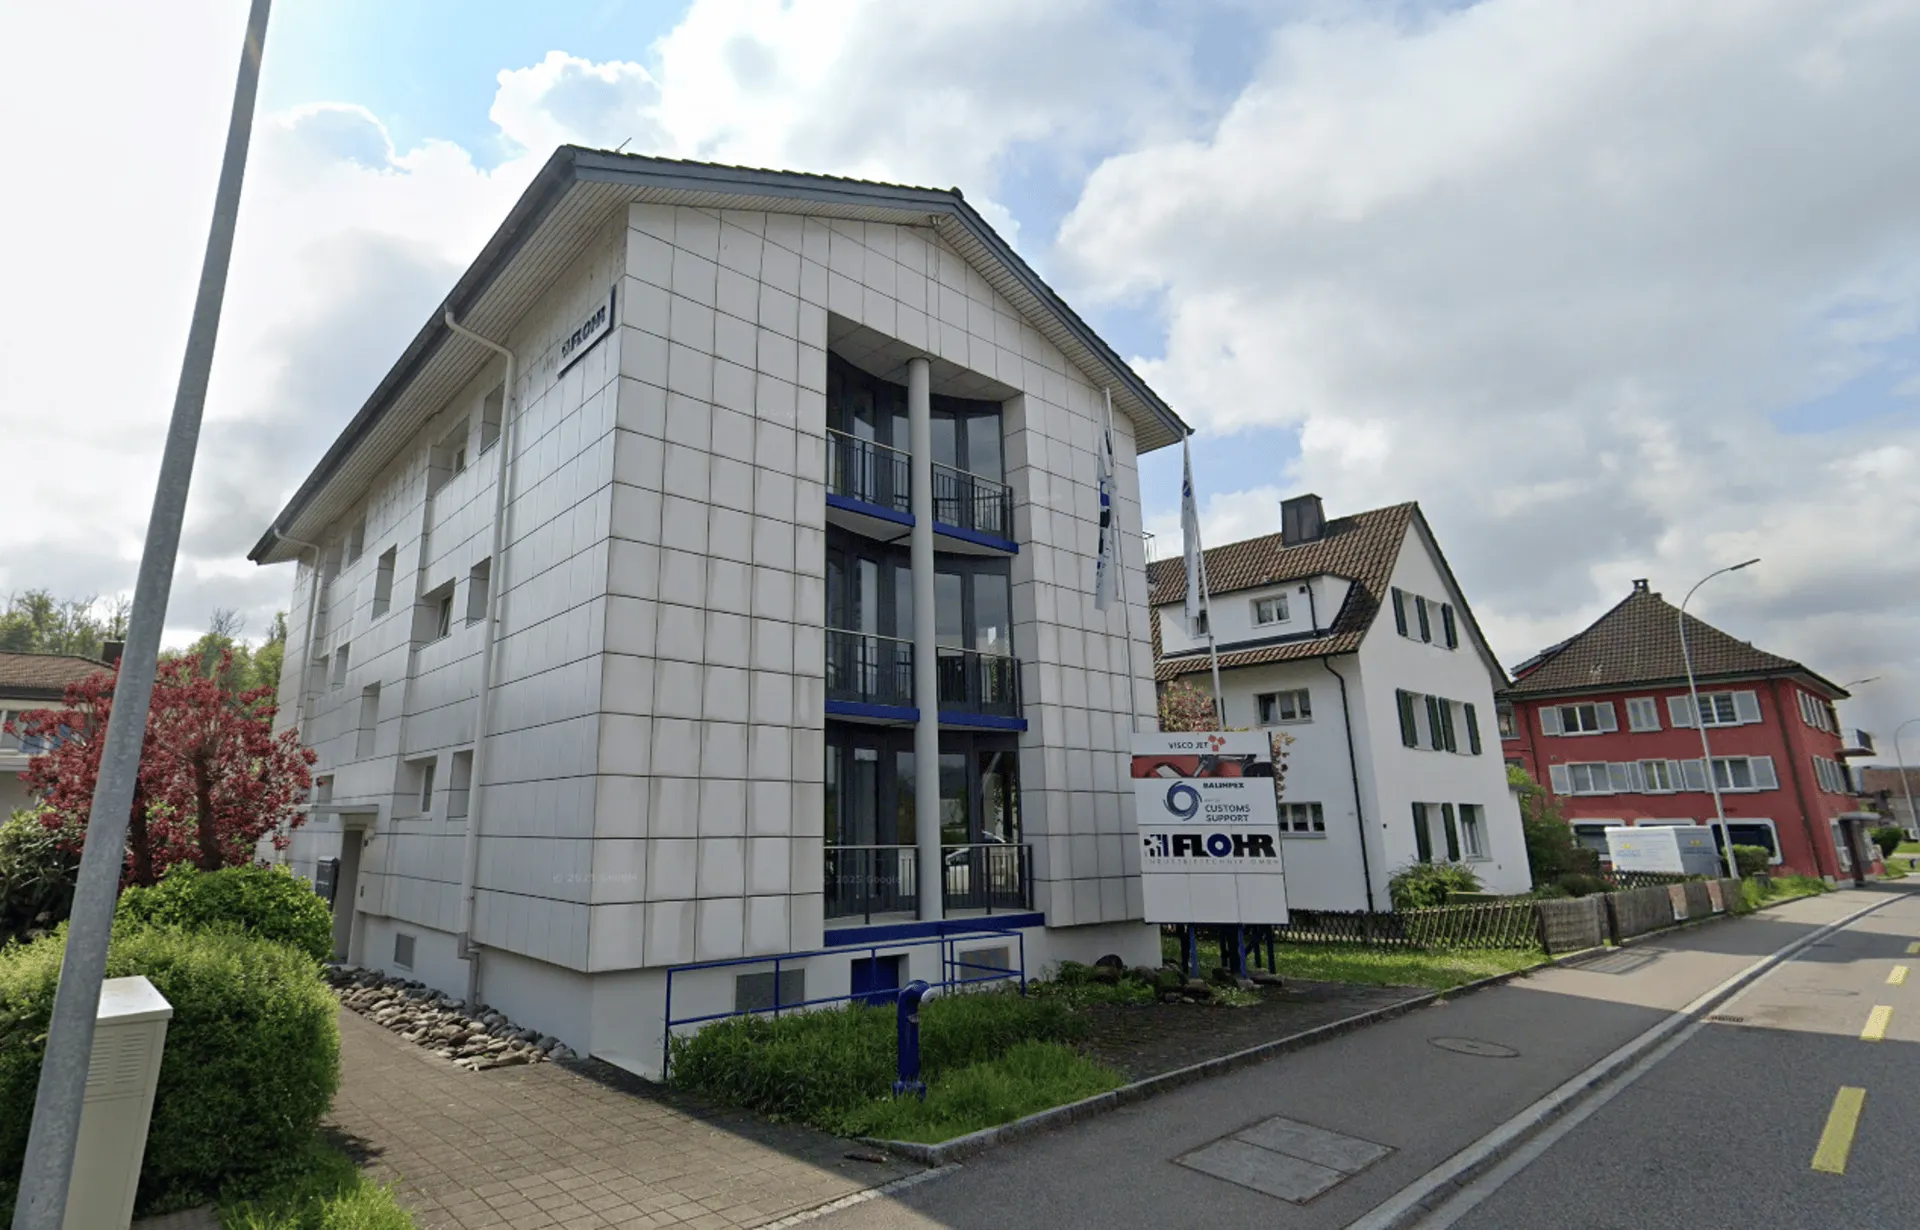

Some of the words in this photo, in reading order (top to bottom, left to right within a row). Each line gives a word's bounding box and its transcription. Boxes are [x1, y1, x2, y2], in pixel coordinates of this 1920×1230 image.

[1168, 741, 1194, 749] VISCO
[1195, 741, 1209, 749] JET
[1205, 804, 1251, 812] CUSTOMS
[1206, 814, 1249, 822] SUPPORT
[1172, 833, 1278, 858] FLOHR
